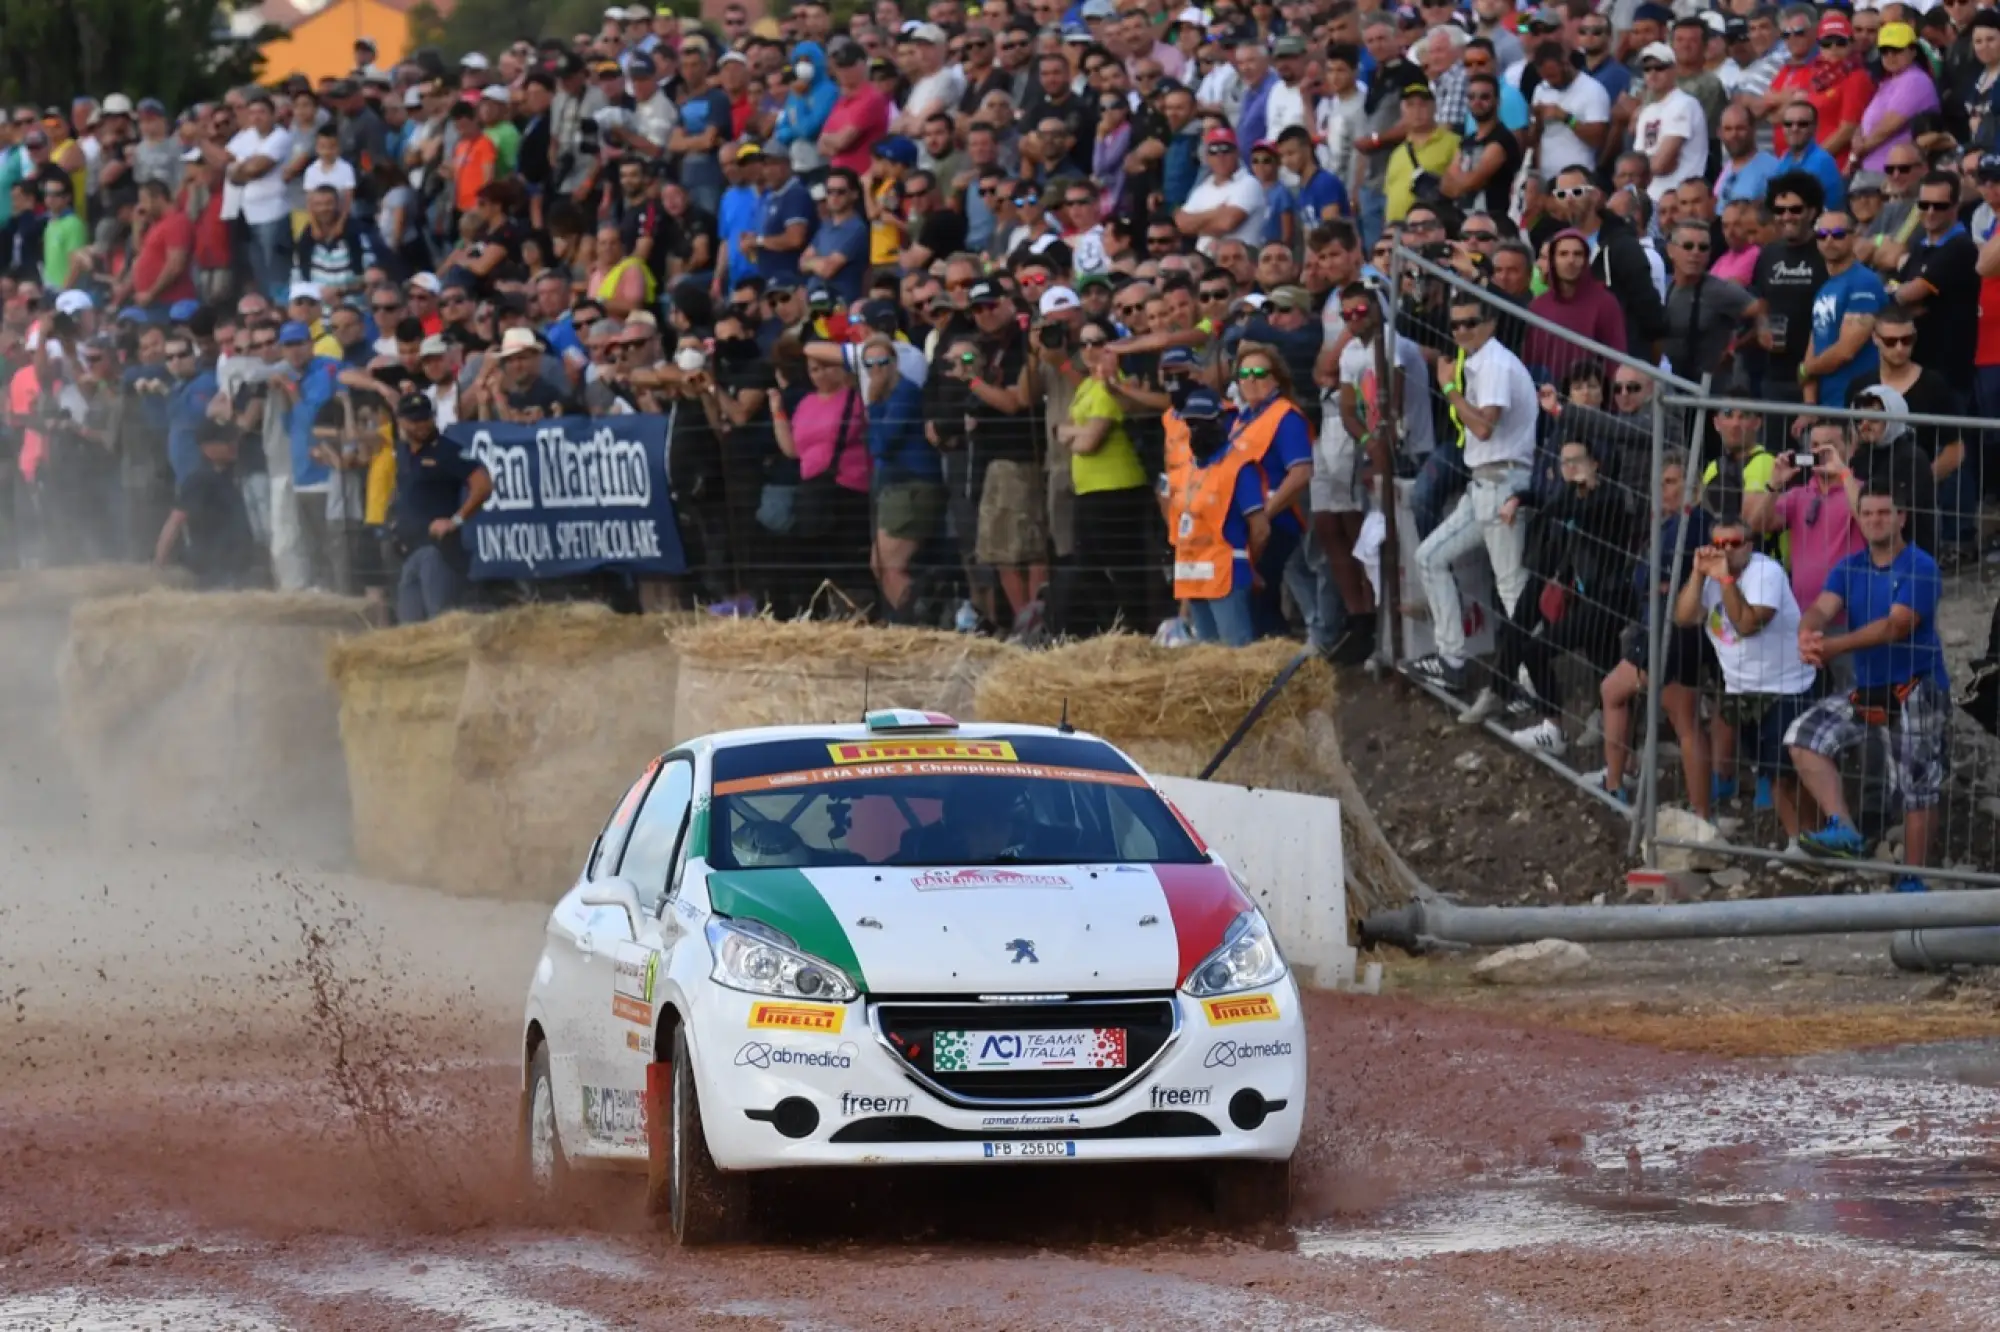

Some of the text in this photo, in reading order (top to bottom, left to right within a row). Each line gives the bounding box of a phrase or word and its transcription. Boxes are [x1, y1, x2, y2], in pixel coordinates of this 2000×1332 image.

[472, 426, 651, 511] San Martino
[555, 519, 662, 560] SPETTACOLARE
[823, 767, 853, 779] FIA
[855, 765, 893, 776] WRC
[901, 763, 914, 774] 3
[919, 762, 1043, 777] Championship
[756, 1006, 835, 1029] PIRELLI
[1210, 997, 1274, 1021] PIRELLI
[979, 1034, 1023, 1060] ACI
[1022, 1047, 1077, 1059] ITALIA
[841, 1091, 911, 1115] freem
[1151, 1085, 1211, 1108] freem
[994, 1142, 1012, 1155] FB
